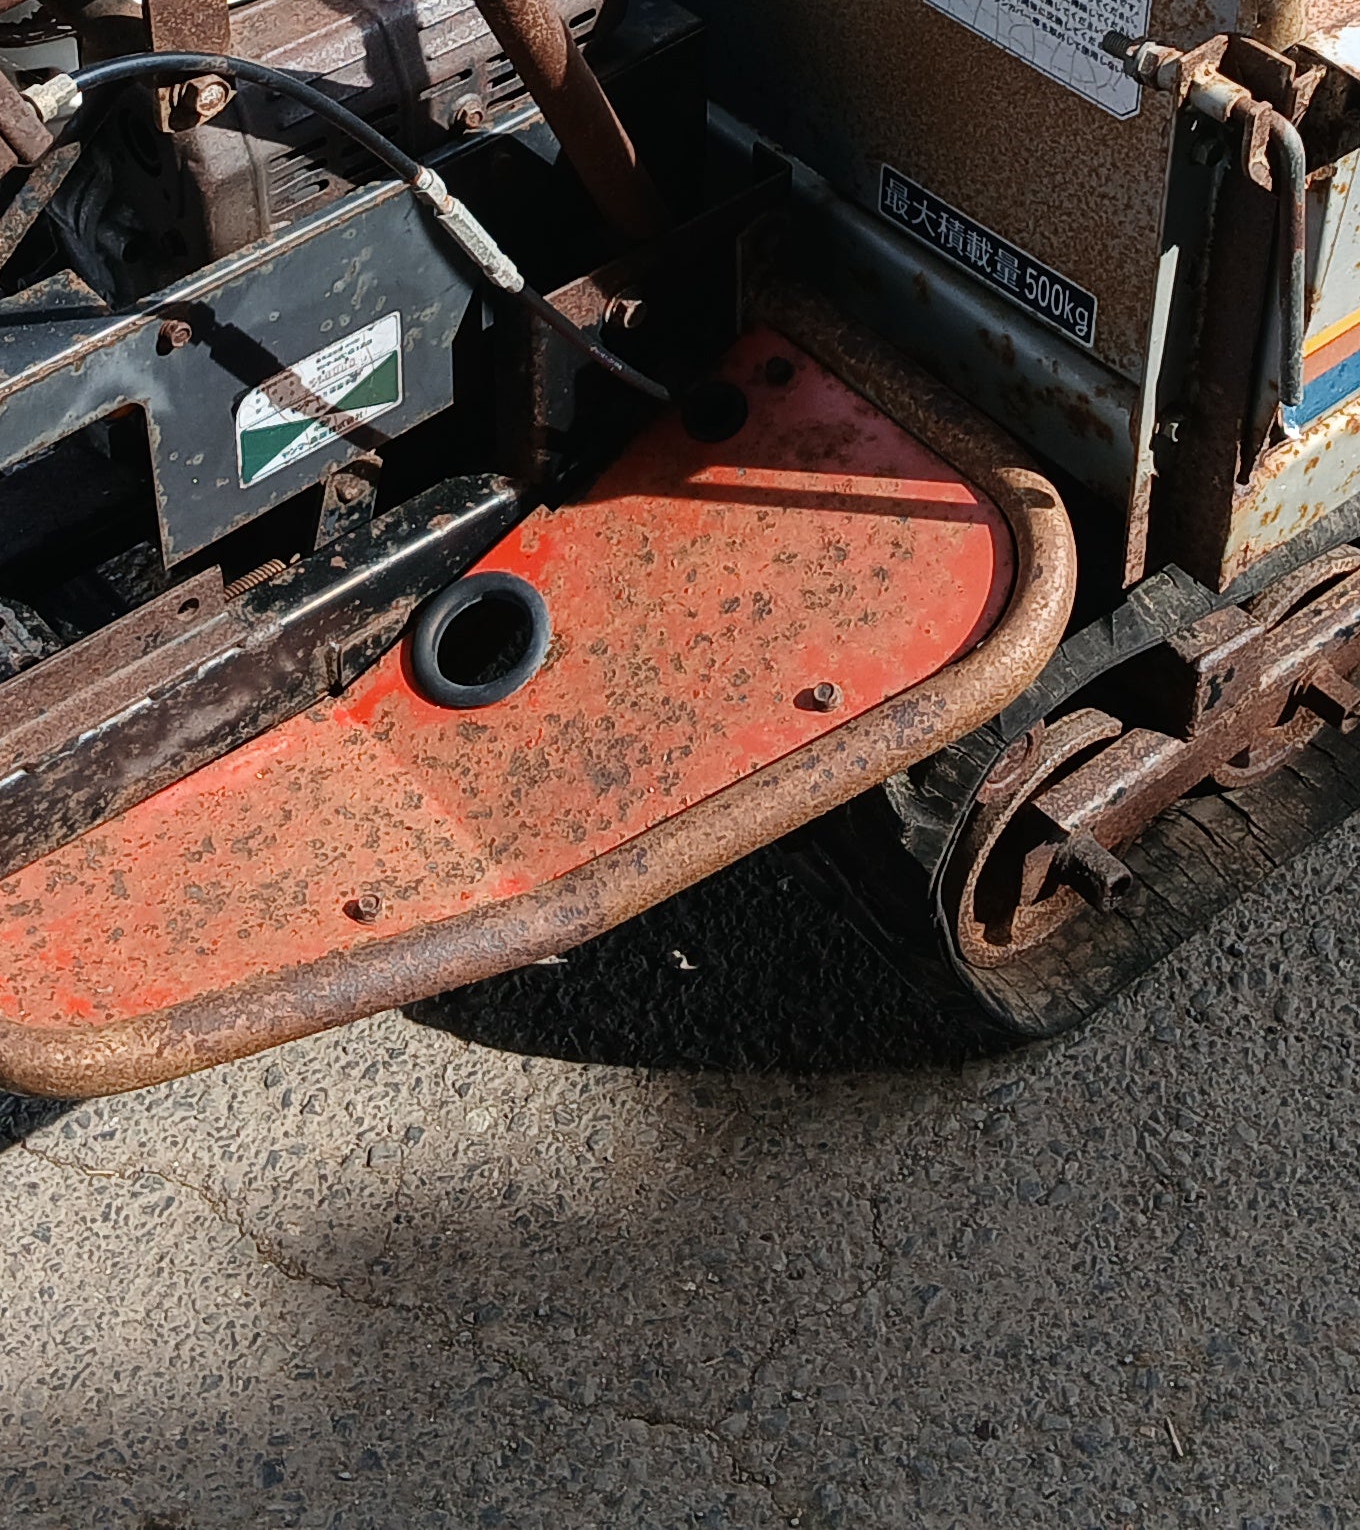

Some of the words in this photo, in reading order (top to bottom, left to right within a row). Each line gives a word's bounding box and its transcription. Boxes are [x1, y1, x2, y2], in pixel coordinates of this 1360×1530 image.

[884, 178, 1089, 337] 最大積載量500kg
